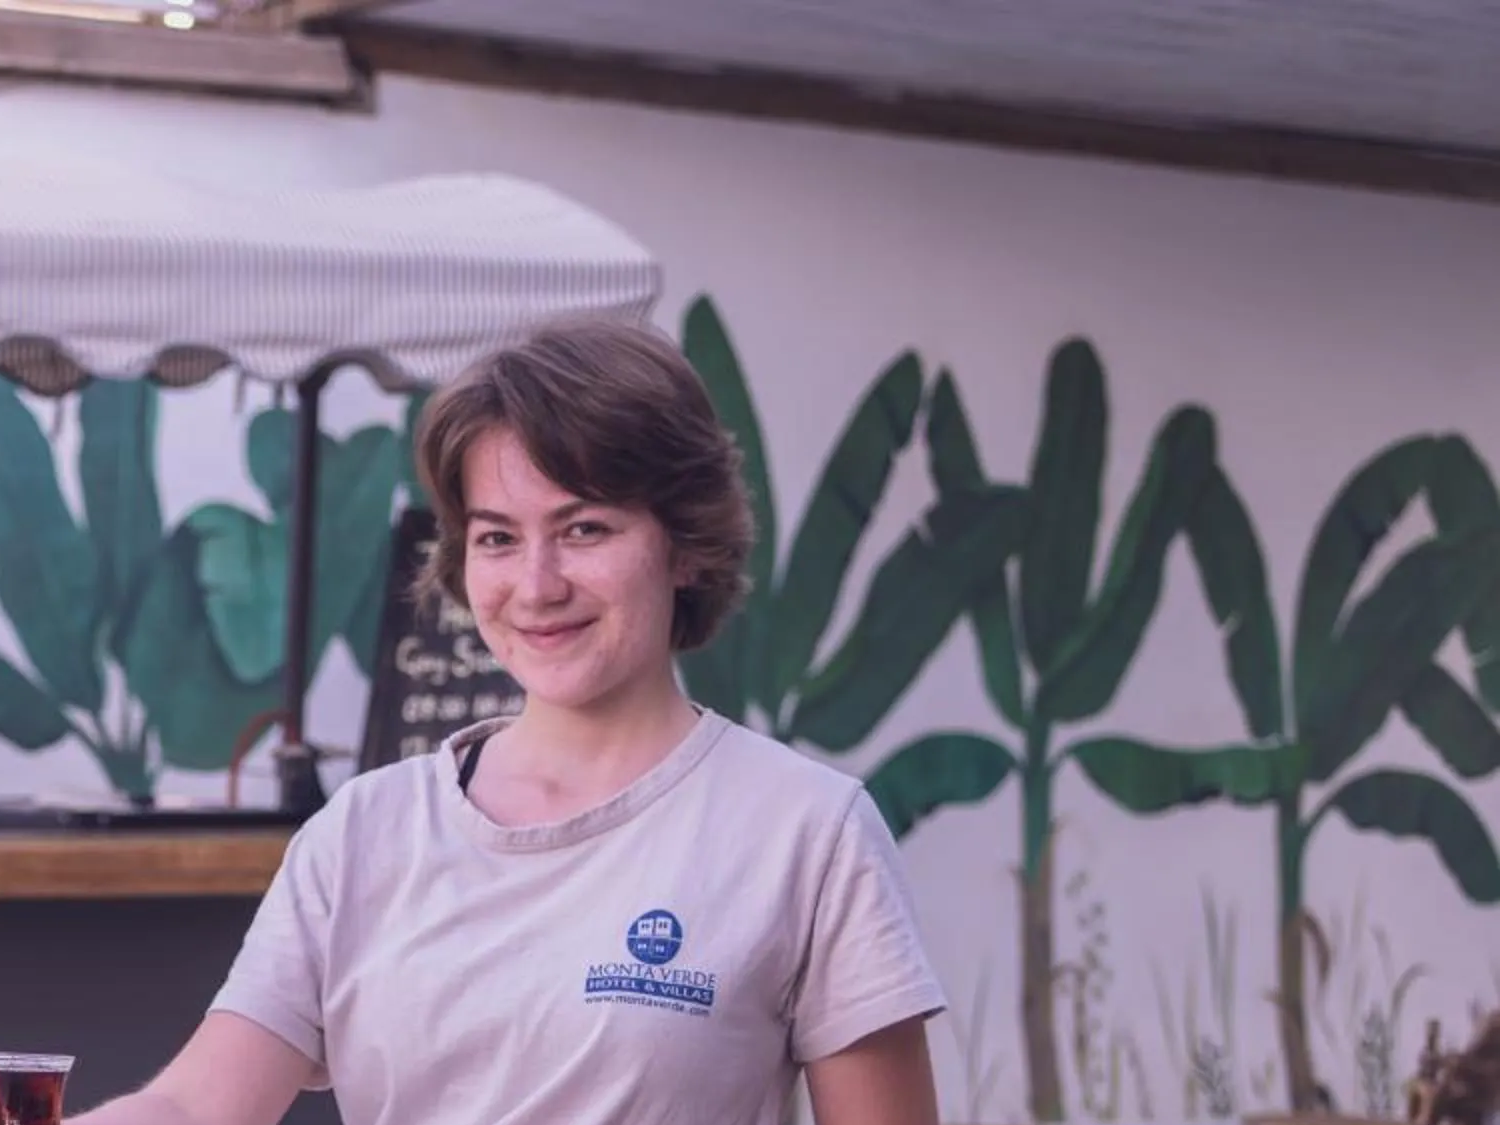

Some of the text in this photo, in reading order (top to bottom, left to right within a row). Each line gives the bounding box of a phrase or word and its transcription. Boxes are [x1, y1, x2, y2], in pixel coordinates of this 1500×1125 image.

[588, 963, 717, 988] MONTA VERDE
[589, 978, 711, 1002] HOTEL & VILLAS
